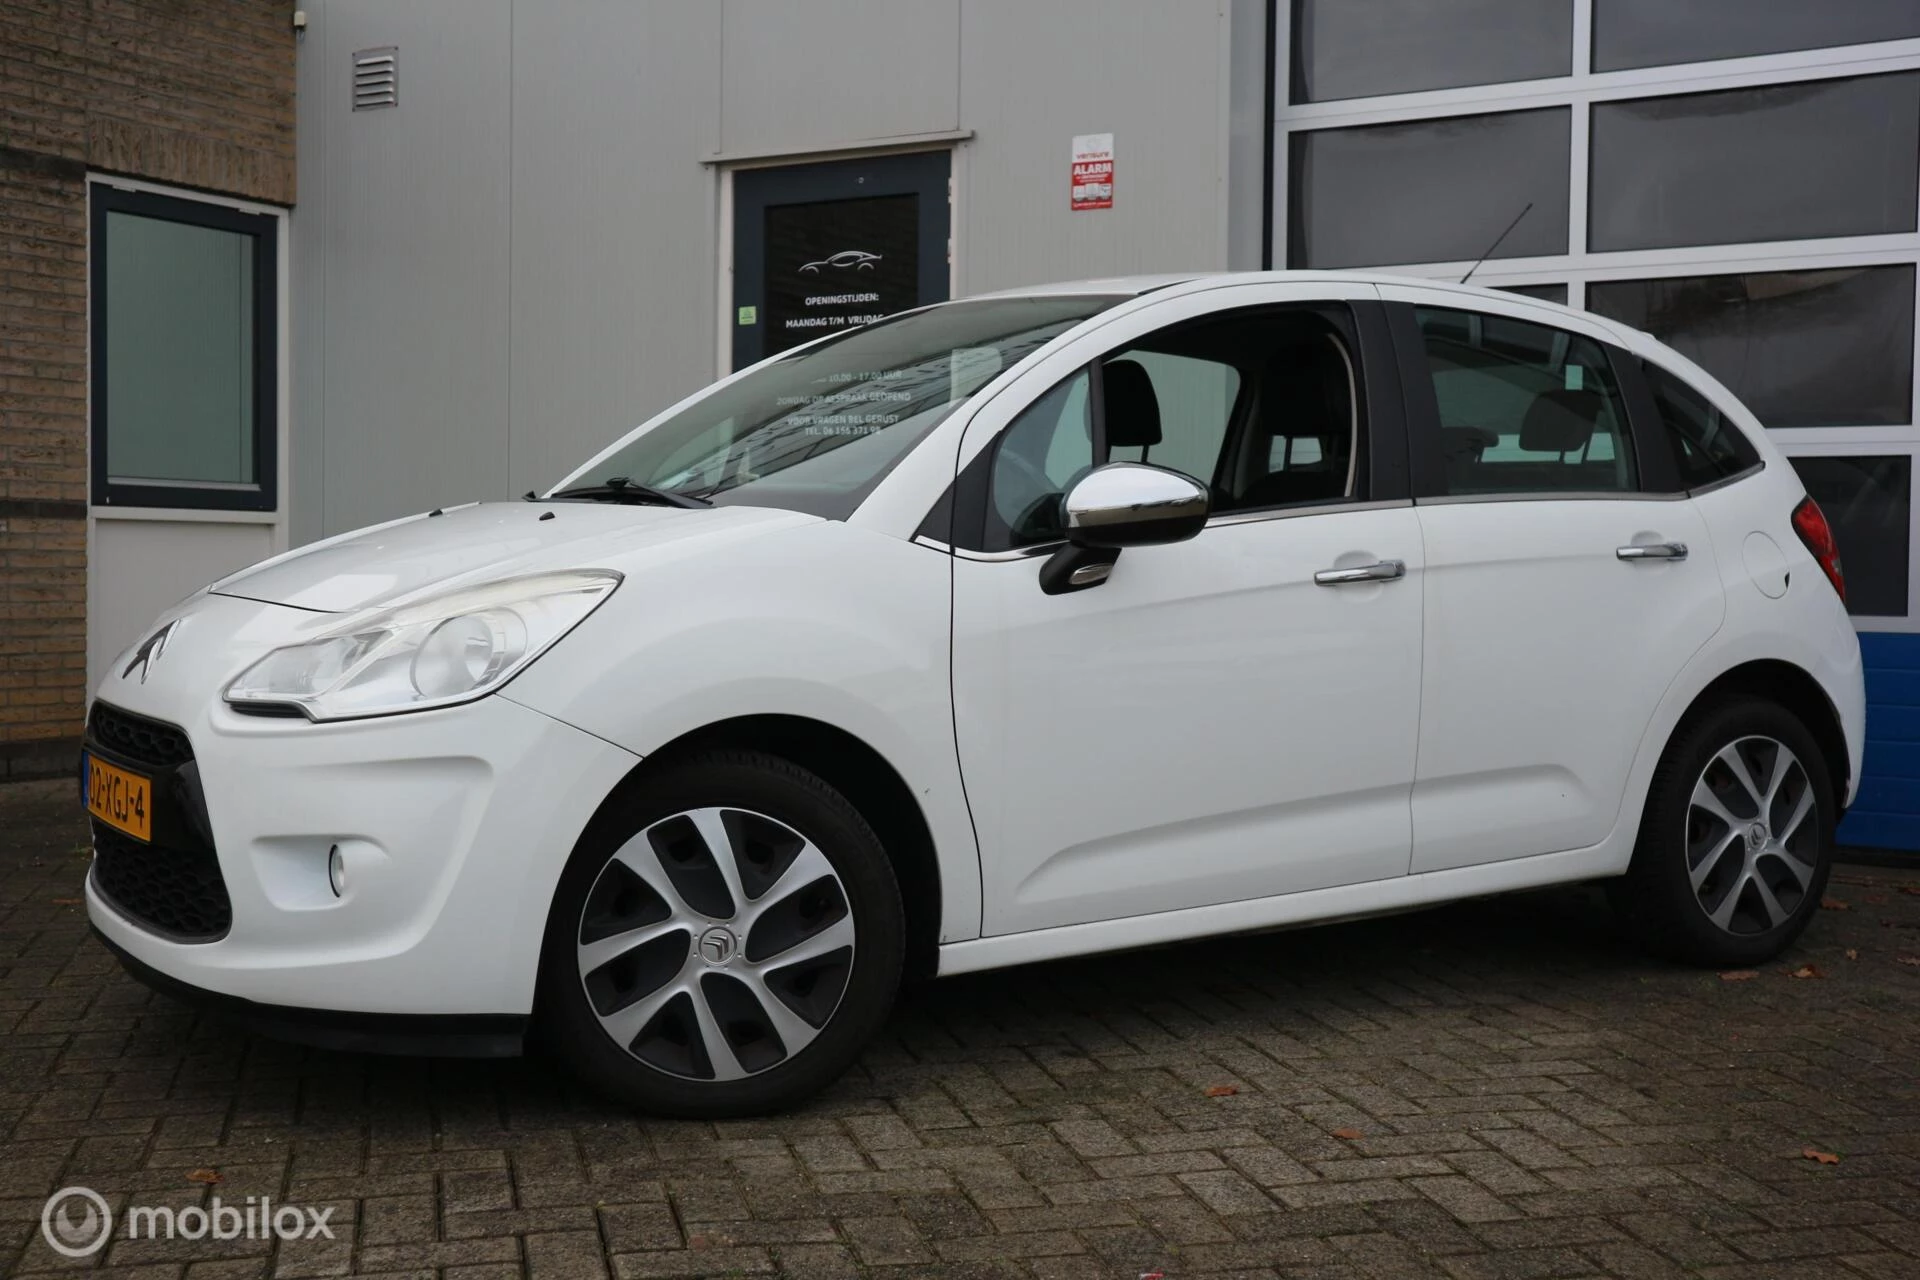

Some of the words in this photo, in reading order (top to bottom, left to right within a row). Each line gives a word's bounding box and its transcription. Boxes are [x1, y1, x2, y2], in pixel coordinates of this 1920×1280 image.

[1074, 162, 1112, 175] ALARM
[805, 293, 880, 306] OPENINGSTIJDEN:
[786, 318, 827, 328] MAANDAG
[828, 317, 844, 325] T/M
[869, 391, 911, 401] GEOPEND
[848, 415, 864, 423] BEL
[865, 414, 899, 423] GERUST
[90, 763, 145, 829] 02-XGJ-4
